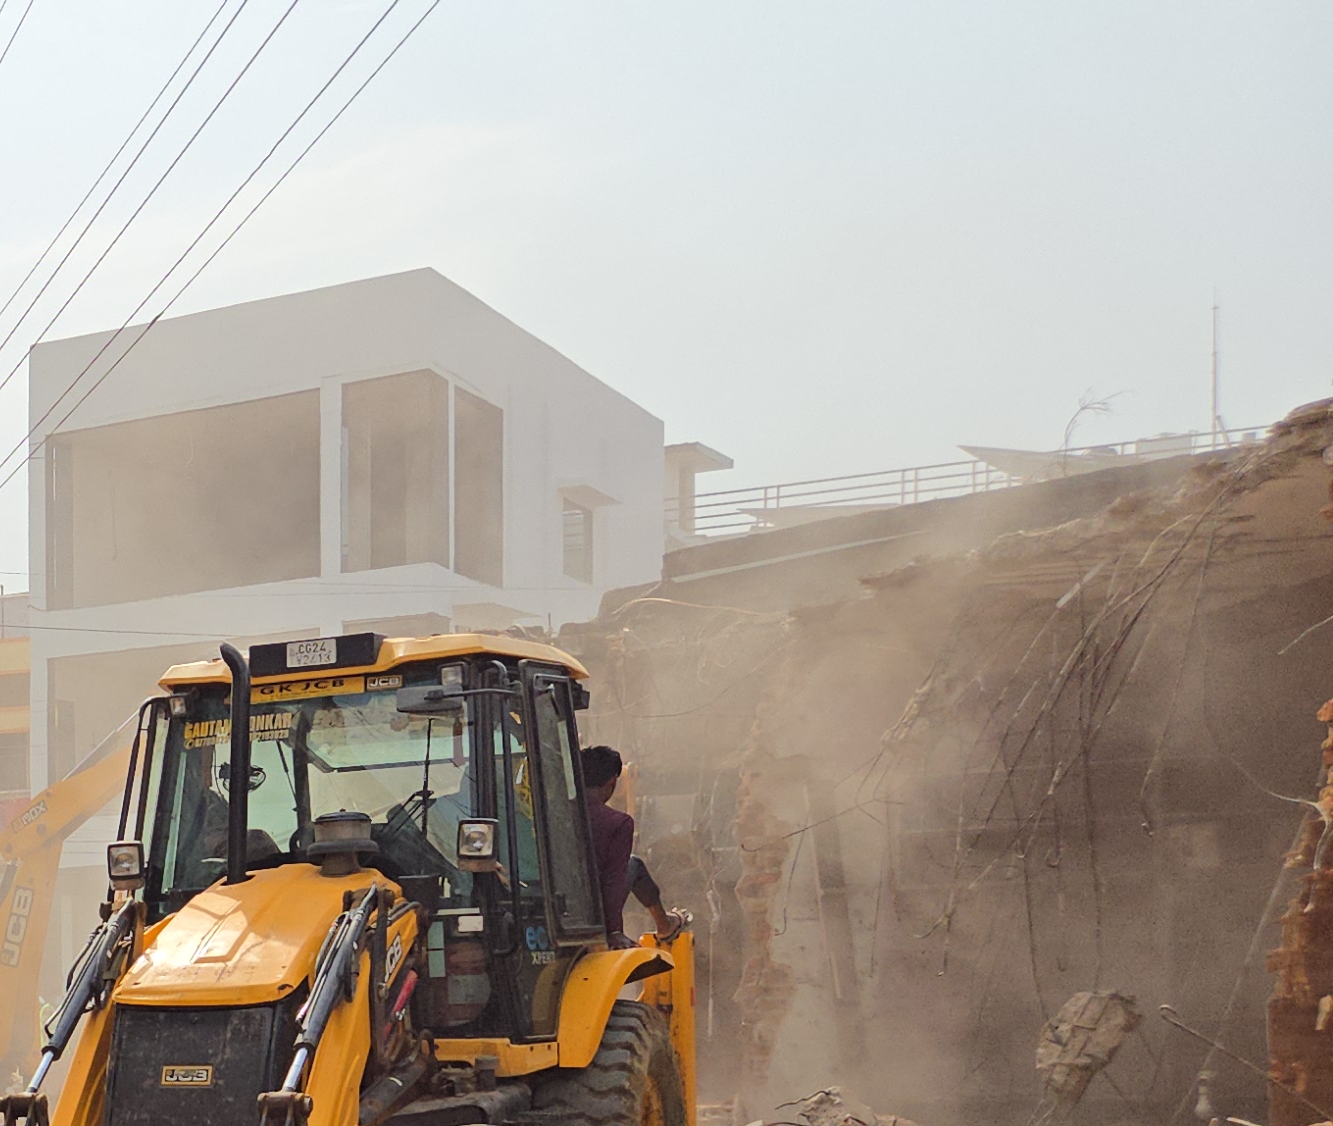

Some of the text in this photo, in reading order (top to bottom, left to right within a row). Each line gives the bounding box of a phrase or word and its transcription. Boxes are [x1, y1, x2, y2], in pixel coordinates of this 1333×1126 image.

[298, 641, 326, 655] CG24
[301, 678, 345, 691] JCB
[369, 677, 400, 688] JCB
[0, 888, 33, 966] JCB
